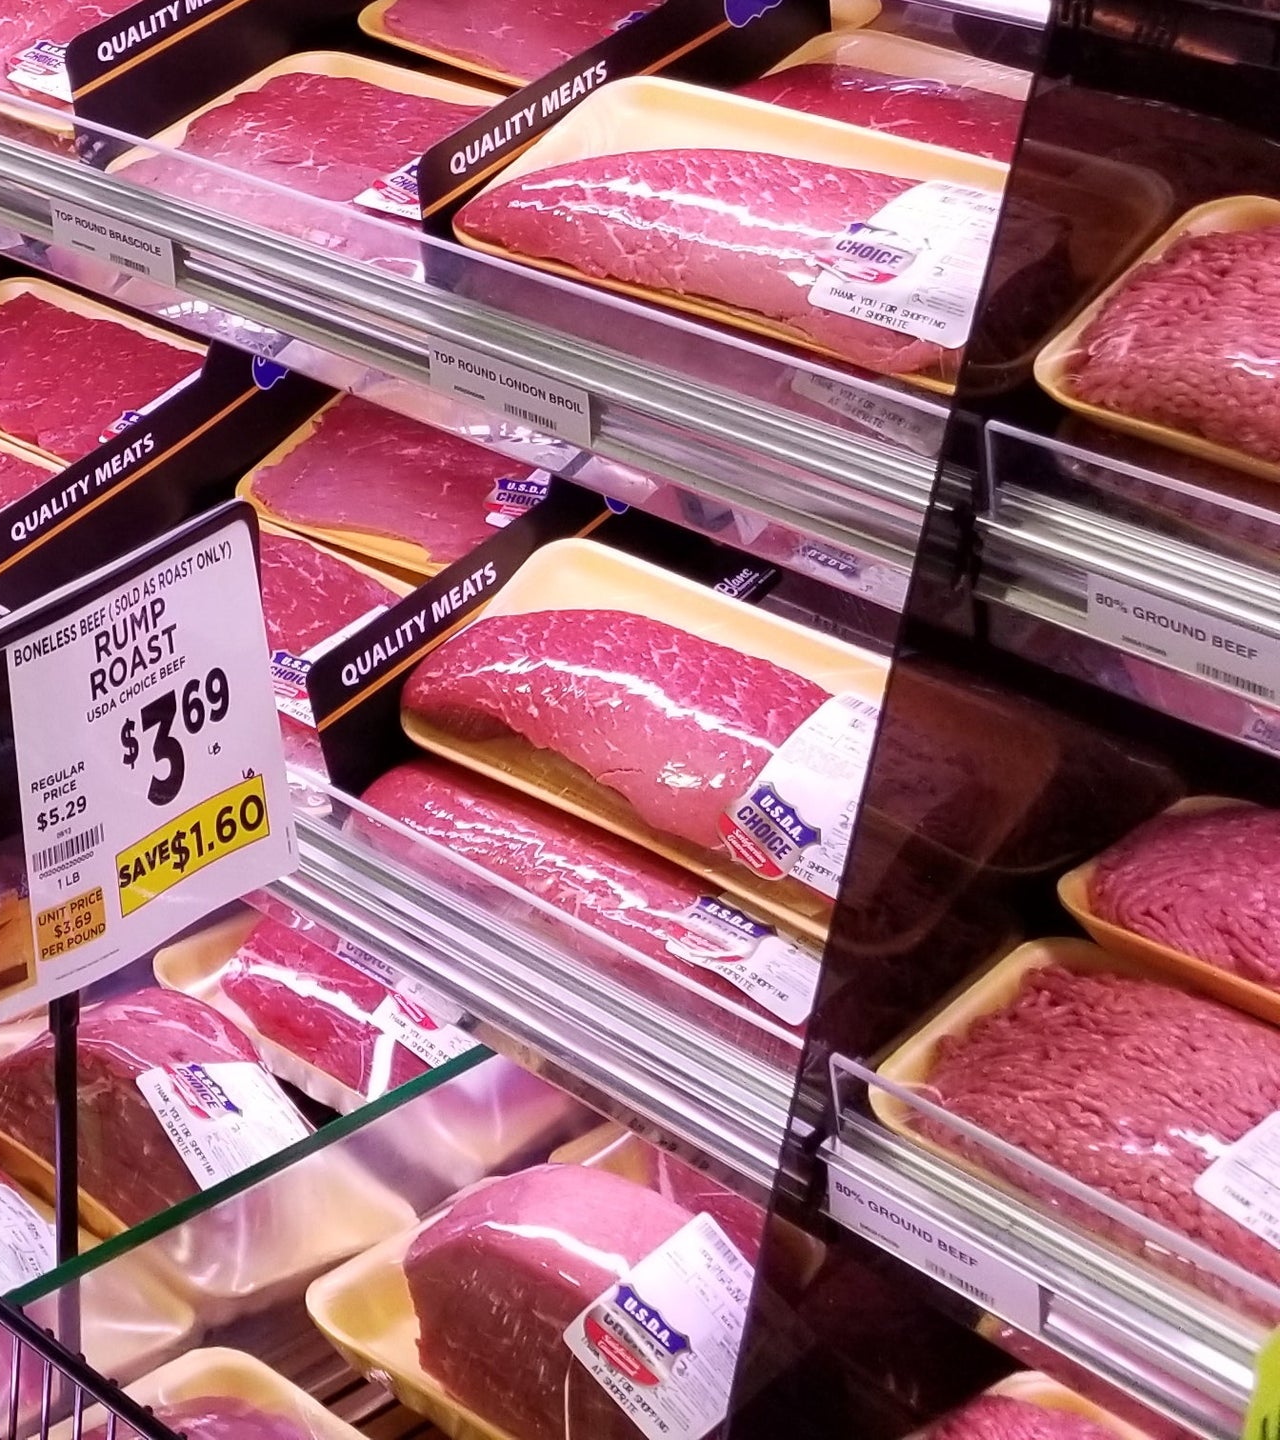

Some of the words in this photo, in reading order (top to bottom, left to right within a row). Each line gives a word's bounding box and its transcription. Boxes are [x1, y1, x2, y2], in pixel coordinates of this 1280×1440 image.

[95, 598, 166, 663] RUMP
[1133, 607, 1206, 642] GROUND
[1211, 635, 1258, 660] BEEF
[90, 624, 178, 703] ROAST
[737, 806, 792, 860] CHOICE
[760, 795, 804, 841] U.S.D.A.
[38, 907, 68, 928] UNIT
[70, 889, 104, 915] PRICE
[54, 911, 93, 939] $3.69
[41, 940, 67, 959] PER
[70, 922, 106, 948] POUND
